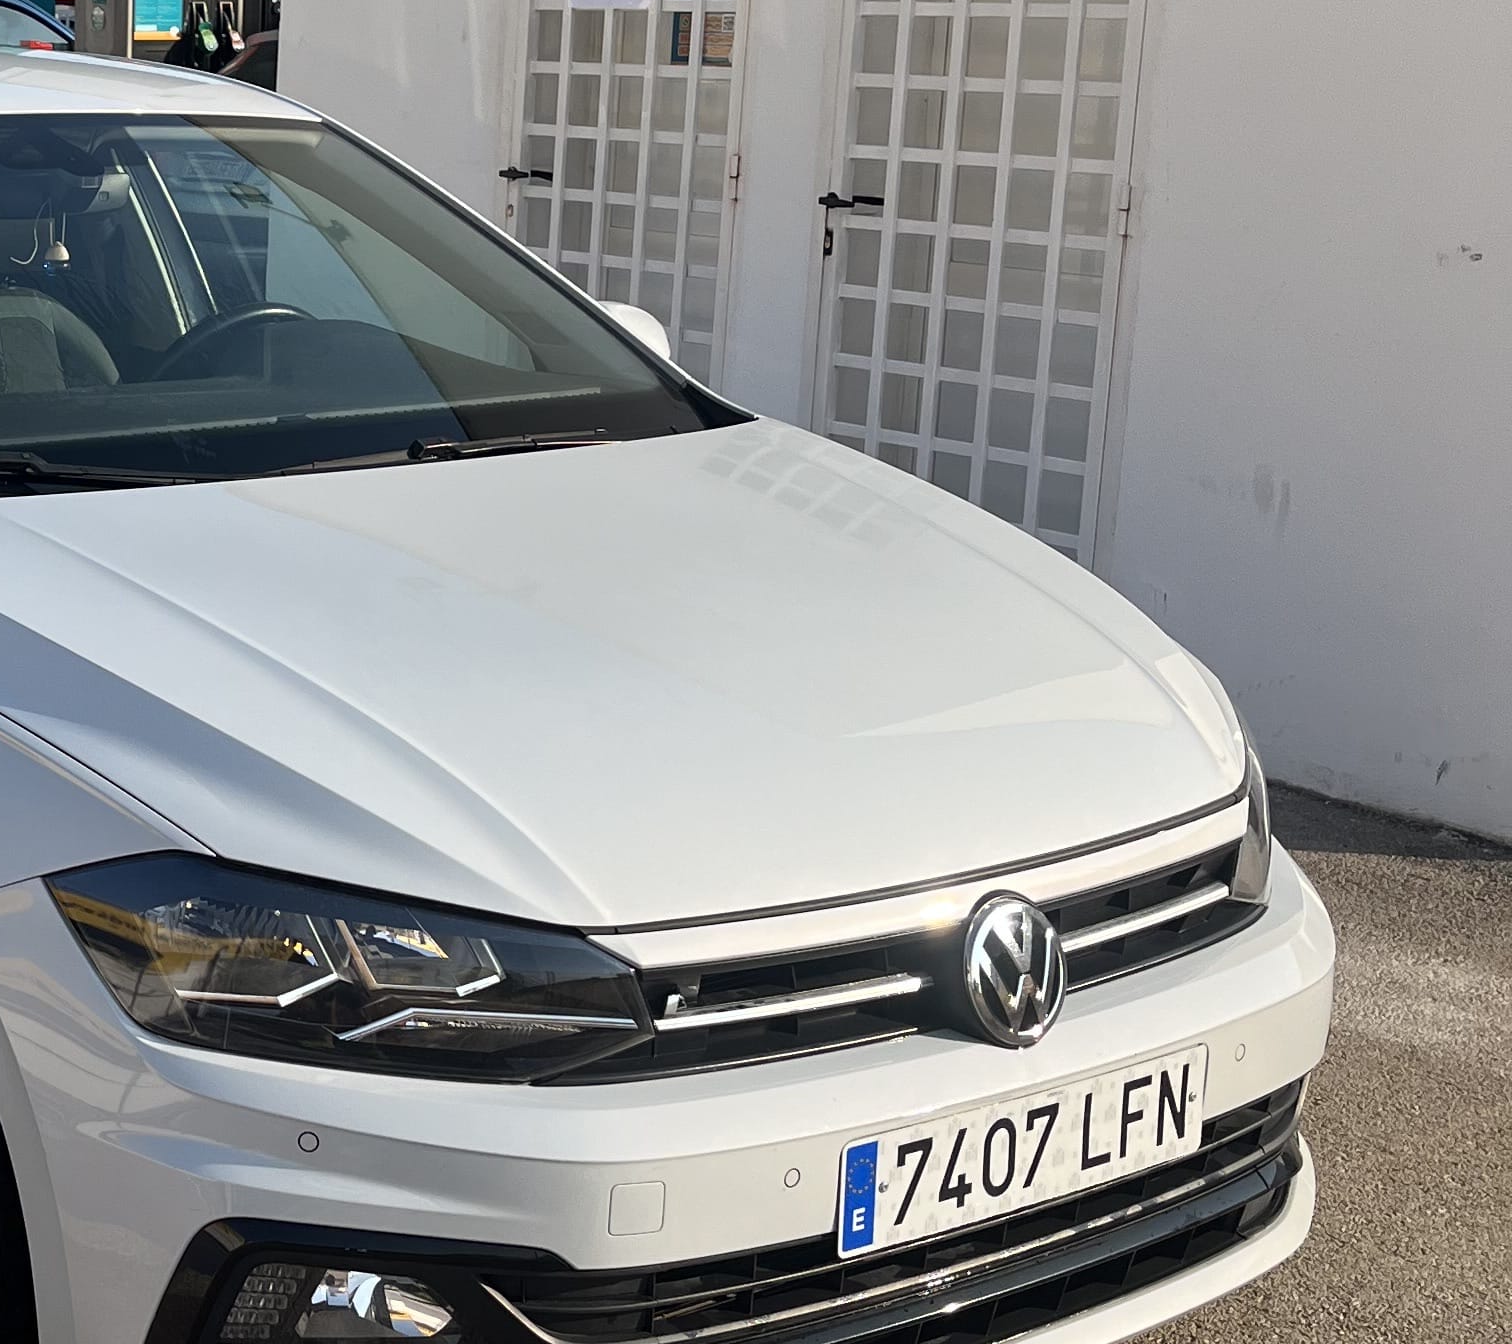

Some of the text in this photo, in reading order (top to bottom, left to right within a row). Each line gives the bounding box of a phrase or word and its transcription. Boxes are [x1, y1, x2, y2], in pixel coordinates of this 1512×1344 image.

[893, 1063, 1190, 1227] 7407 LFN
[852, 1207, 866, 1232] E
